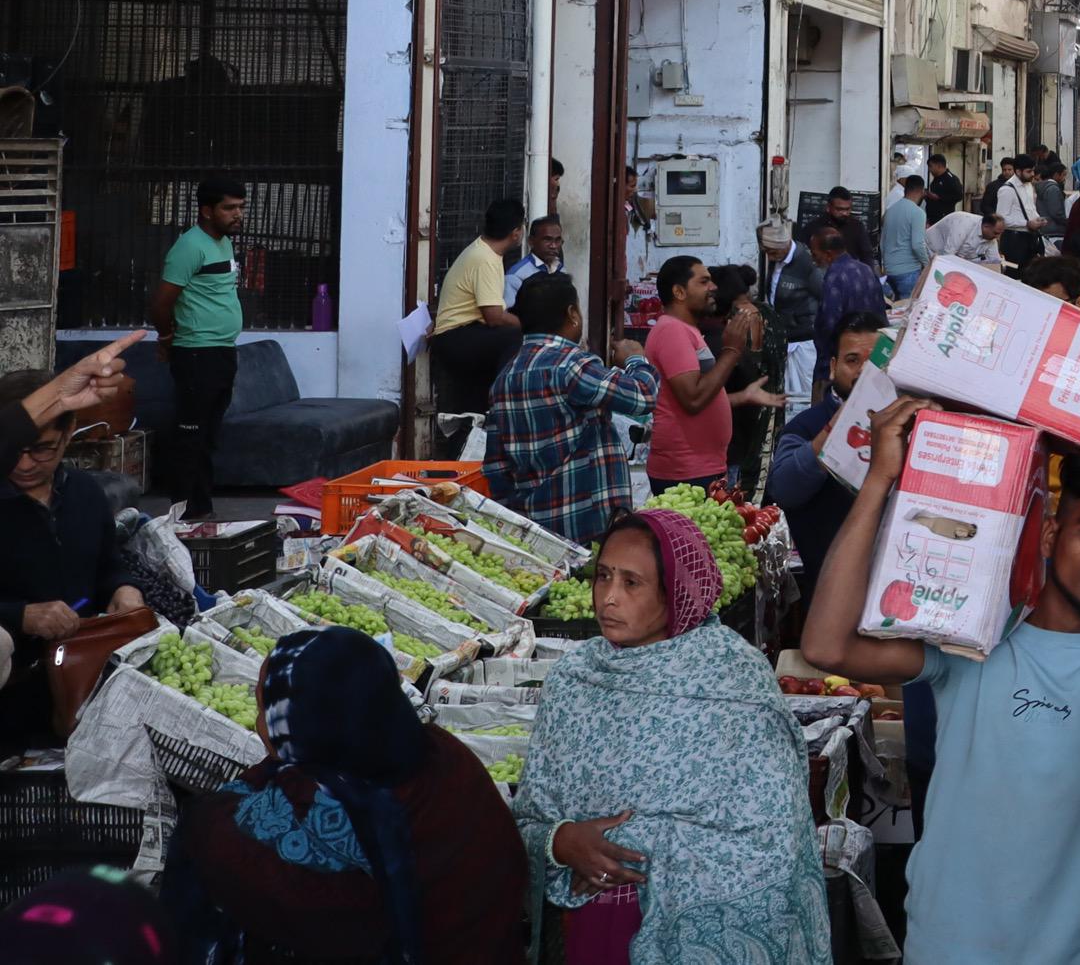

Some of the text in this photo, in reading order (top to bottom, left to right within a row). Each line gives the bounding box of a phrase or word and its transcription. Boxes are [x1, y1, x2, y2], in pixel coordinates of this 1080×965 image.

[937, 304, 969, 358] Apple
[916, 449, 965, 470] Enterprises
[914, 585, 969, 611] Apple
